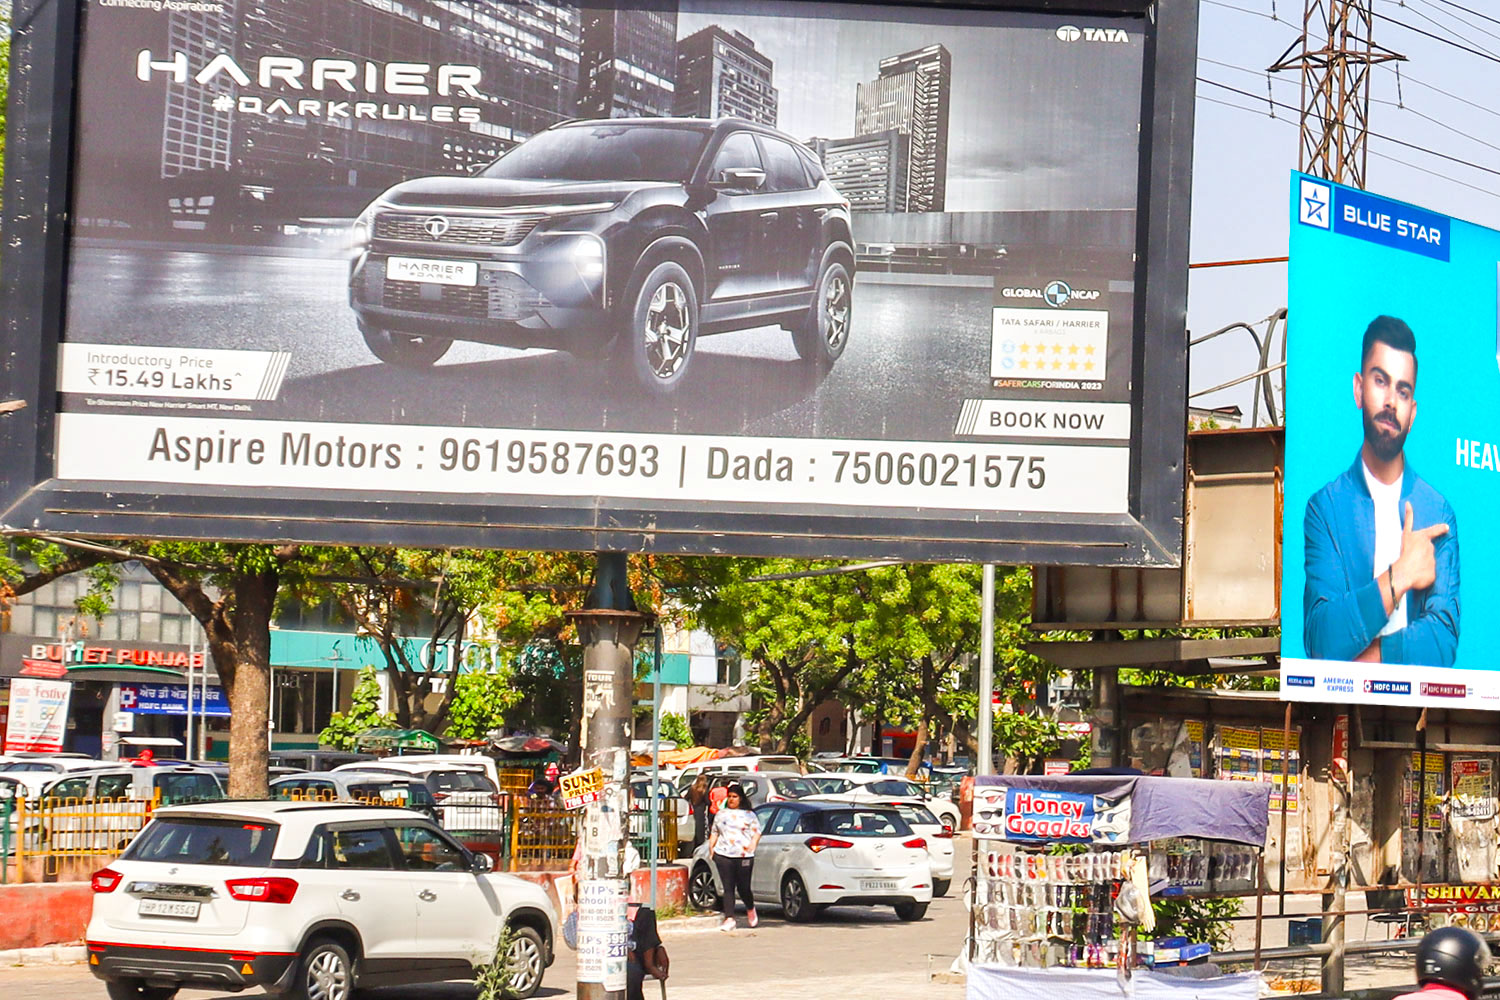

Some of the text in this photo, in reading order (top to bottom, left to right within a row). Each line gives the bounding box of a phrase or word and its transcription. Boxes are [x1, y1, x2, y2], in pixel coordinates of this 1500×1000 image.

[162, 0, 224, 13] Aspirations
[1083, 27, 1129, 43] TATA
[137, 50, 485, 97] HARRIER
[212, 95, 481, 123] #DARKRULES
[1344, 204, 1441, 246] BLUE STAR
[399, 262, 464, 274] HARRIER
[1002, 288, 1100, 300] GLOBAL NCAP
[1001, 318, 1021, 327] TATA
[1023, 319, 1054, 327] SAFARI
[1062, 320, 1100, 329] HARRIER
[87, 352, 213, 369] Introductory Price
[990, 411, 1104, 429] BOOK NOW
[148, 427, 265, 471] Aspire
[280, 432, 402, 470] Motors
[440, 438, 659, 477] 9619587693
[706, 447, 793, 482] Dada
[832, 451, 1046, 489] 7506021575
[116, 649, 206, 668] PUNJAB
[1323, 677, 1354, 685] AMERICAN
[1327, 685, 1354, 693] EXPRESS
[1373, 683, 1409, 692] HDFC BANK
[1015, 792, 1085, 820] Honey
[1007, 814, 1090, 838] Goggles
